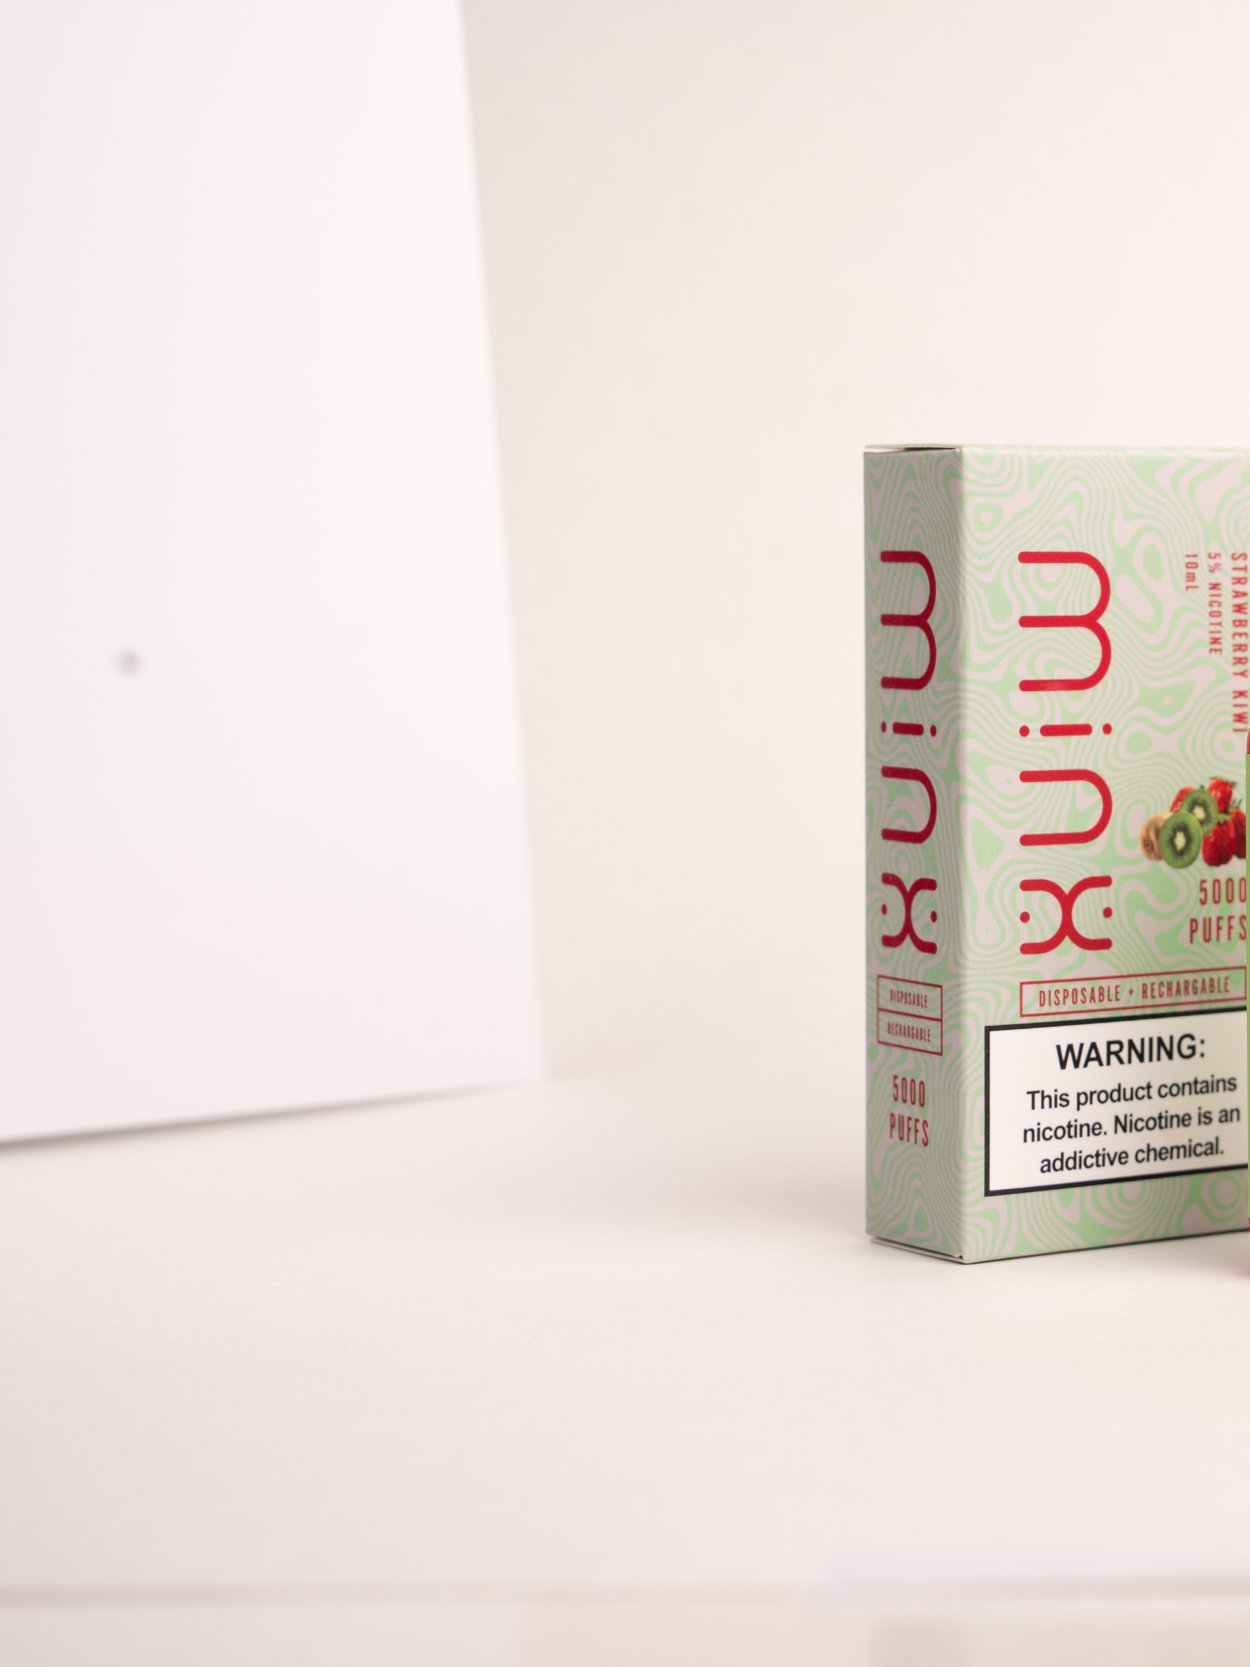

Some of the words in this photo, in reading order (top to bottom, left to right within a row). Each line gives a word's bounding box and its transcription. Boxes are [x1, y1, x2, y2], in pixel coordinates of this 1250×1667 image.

[1184, 553, 1199, 593] 10mL
[1207, 552, 1222, 573] 5%
[1207, 582, 1223, 656] NICOTINE
[1230, 552, 1249, 680] STRAWBERRY
[1232, 690, 1249, 733] KIWI
[1199, 878, 1247, 905] 5000
[1189, 914, 1247, 944] PUFFS
[889, 988, 928, 1009] DISPOSABLE
[1039, 985, 1121, 1008] DISPOSABLE
[1142, 976, 1230, 999] RECHARGABLE
[887, 1021, 931, 1043] RECHARGABLE
[1055, 1033, 1206, 1070] WARNING:
[891, 1074, 926, 1108] 5000
[1026, 1089, 1070, 1111] This
[1075, 1083, 1153, 1112] product
[1157, 1074, 1238, 1098] contains
[889, 1112, 929, 1147] PUFFS
[1022, 1119, 1108, 1144] nicotine.
[1113, 1109, 1193, 1135] Nicotine
[1197, 1105, 1213, 1127] is
[1218, 1105, 1241, 1124] an
[1039, 1144, 1130, 1174] addictive
[1134, 1135, 1225, 1165] chemical.
